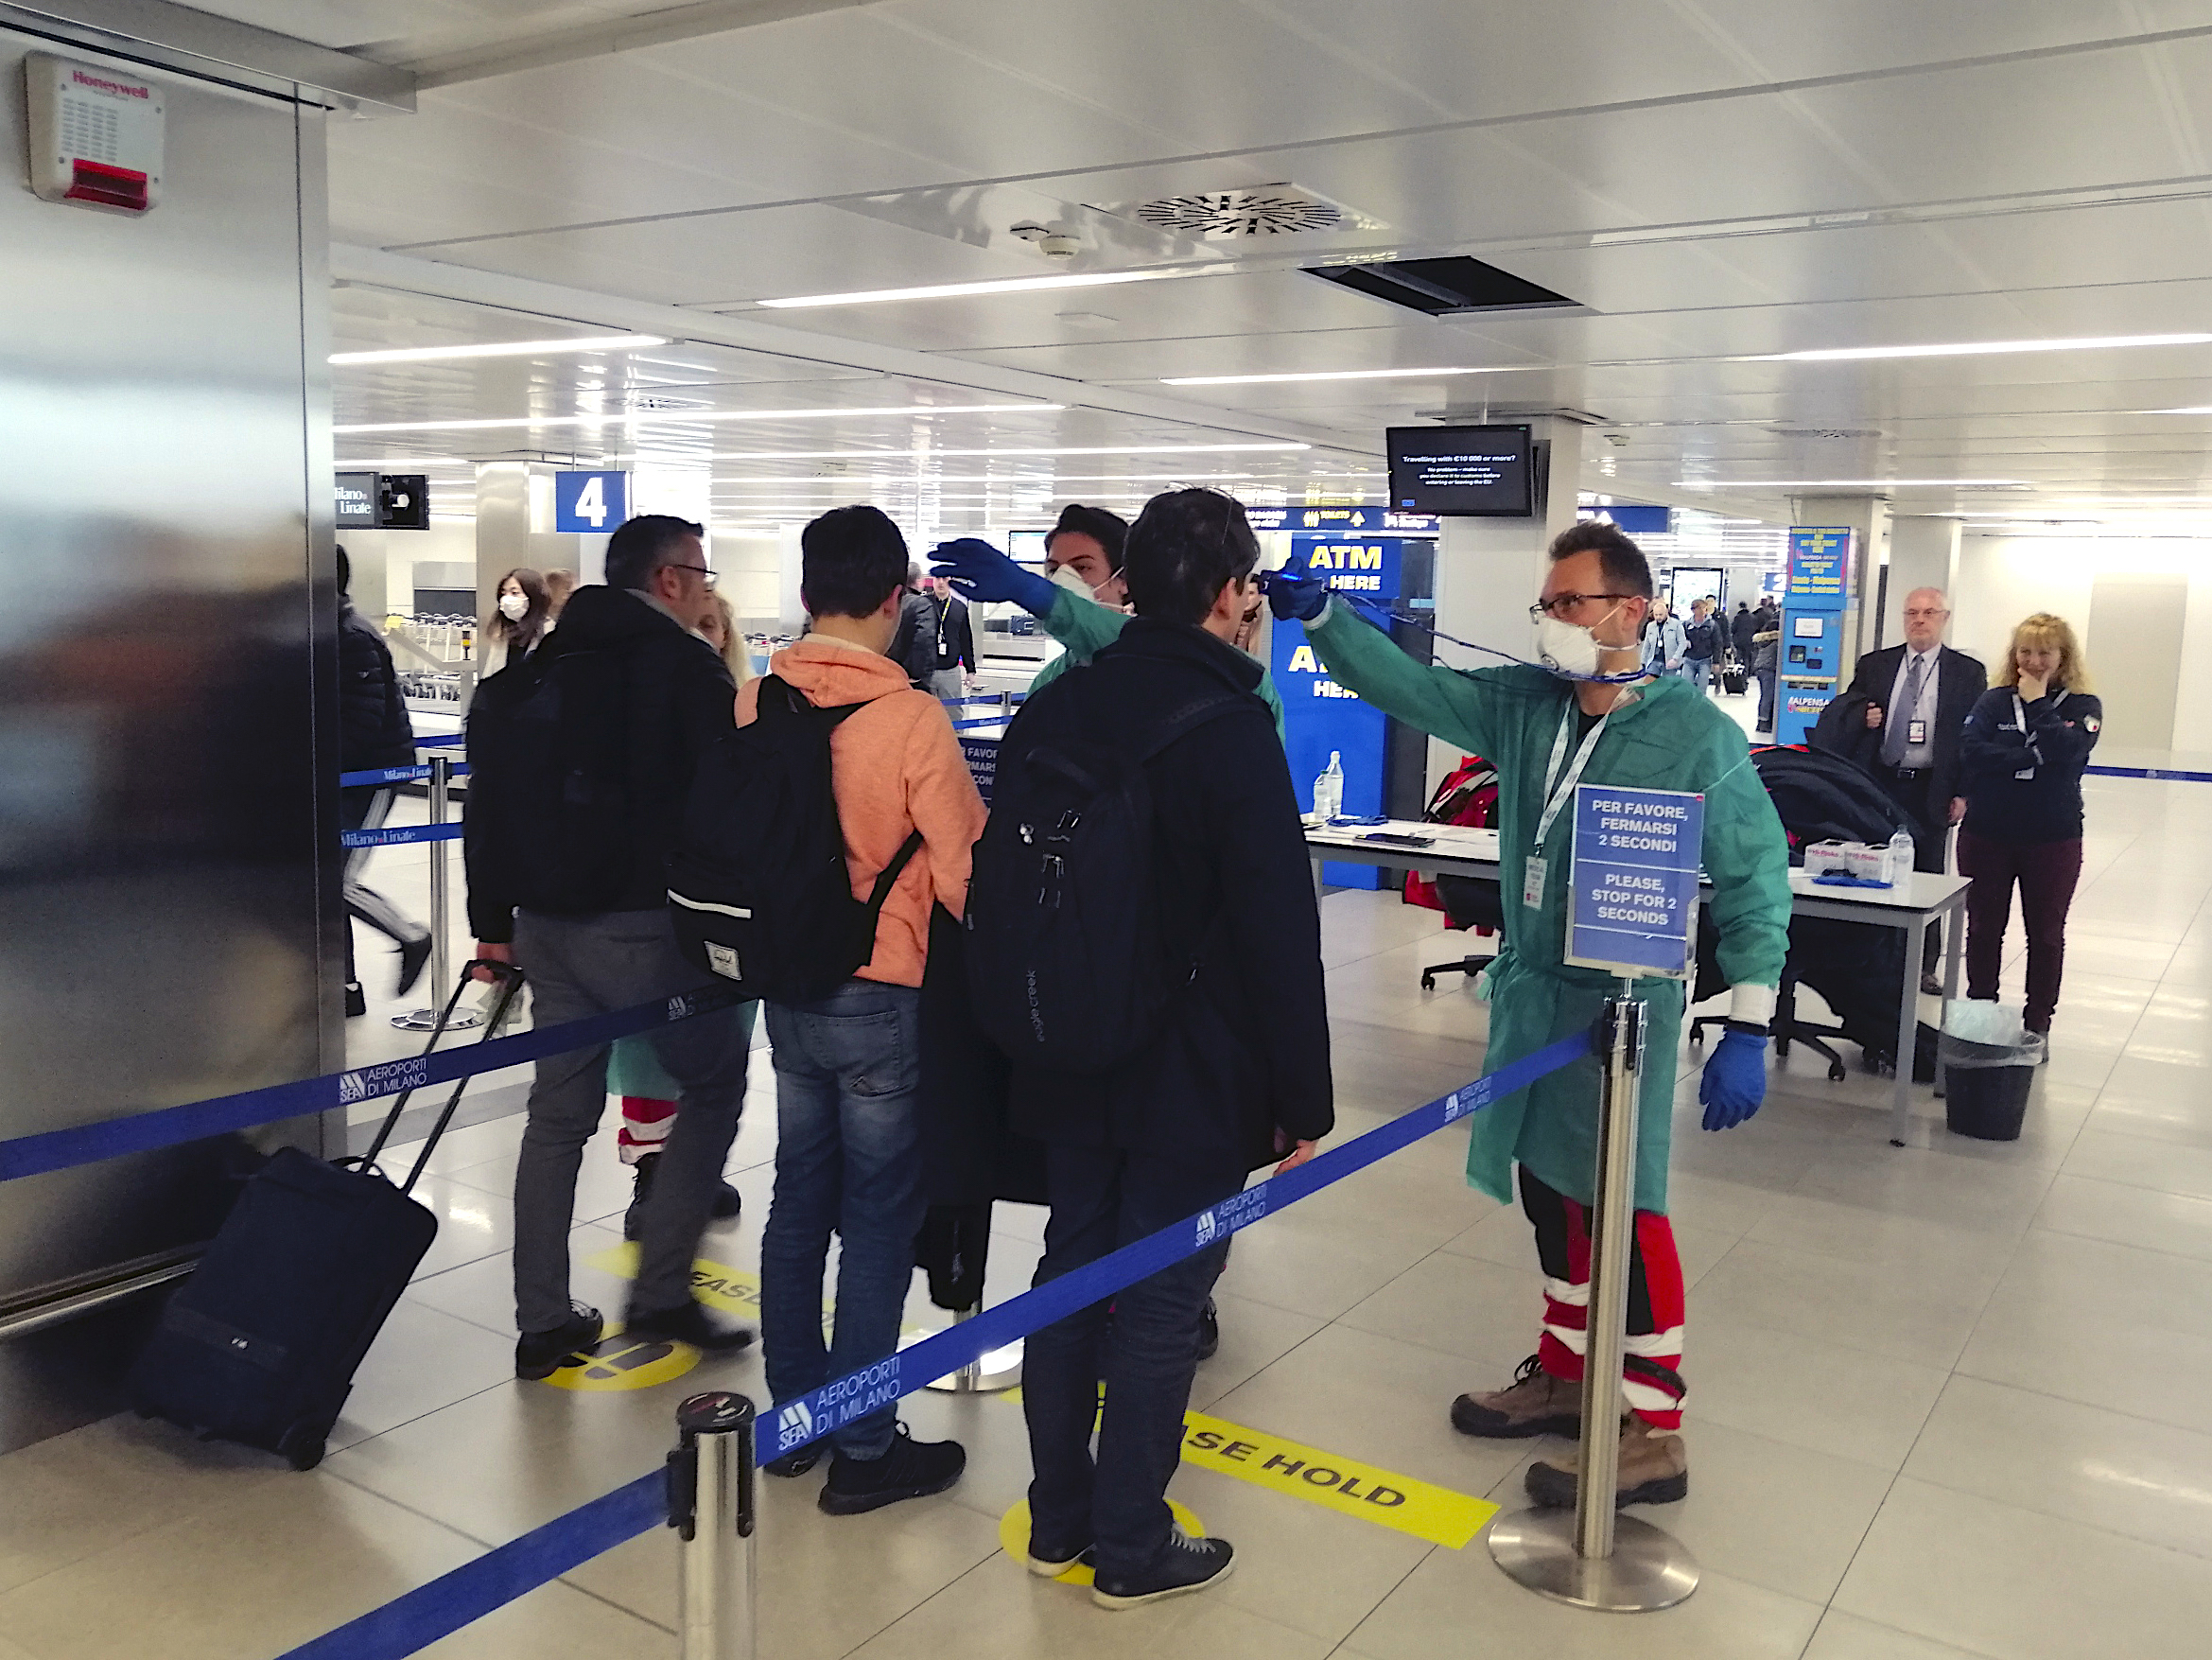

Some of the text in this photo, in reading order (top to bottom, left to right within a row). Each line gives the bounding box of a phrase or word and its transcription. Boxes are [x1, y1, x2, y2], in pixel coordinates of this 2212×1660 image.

[73, 70, 148, 98] Honeywell
[340, 501, 371, 514] Linate
[575, 477, 607, 527] 4
[1308, 546, 1383, 569] ATM
[1330, 575, 1381, 590] HERE
[967, 747, 999, 760] FAVO
[411, 767, 432, 778] Linat
[1592, 799, 1688, 822] PER FAVORE,
[1600, 817, 1677, 836] FERMARSI
[1598, 834, 1677, 852] 2 SECONDI
[1605, 874, 1664, 893] PLEASE,
[1592, 889, 1677, 910] STOP FOR 2
[1597, 906, 1668, 925] SECONDS
[367, 1058, 427, 1082] AEROPORTI
[340, 1072, 427, 1102] SEA DI MILANO
[815, 1356, 900, 1412] AEROPORTI
[778, 1379, 901, 1451] SEA DI MILANO
[1182, 1426, 1406, 1508] SE HOLD
